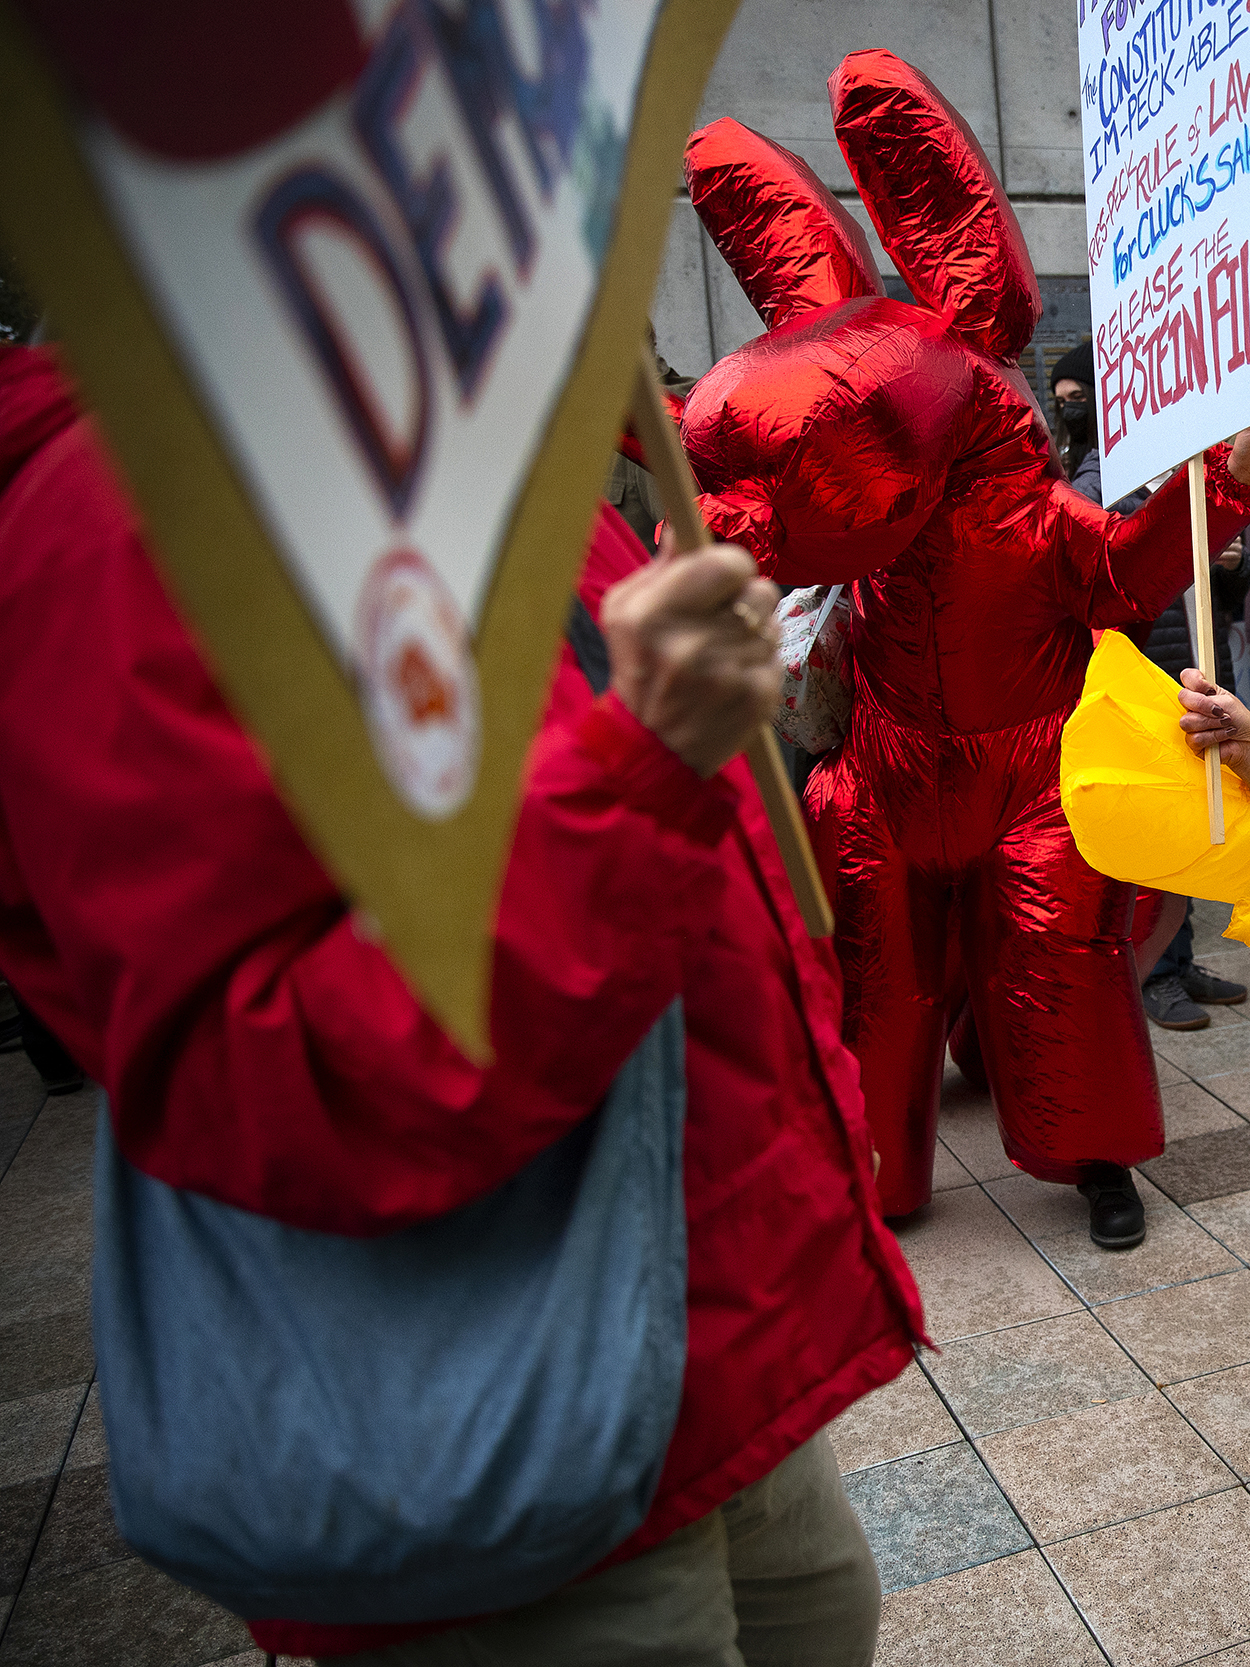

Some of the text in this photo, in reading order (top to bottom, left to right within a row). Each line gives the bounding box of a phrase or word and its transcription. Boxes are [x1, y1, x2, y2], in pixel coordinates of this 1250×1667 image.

[1082, 0, 1226, 128] The CONSTITU
[1090, 0, 1249, 184] IM-PECK-ABLE
[1136, 123, 1182, 211] RULE
[1188, 105, 1203, 156] of
[1137, 153, 1216, 260] CLUCK'S
[1096, 218, 1232, 369] RELEASE THE
[1101, 286, 1209, 458] EPSTEIN
